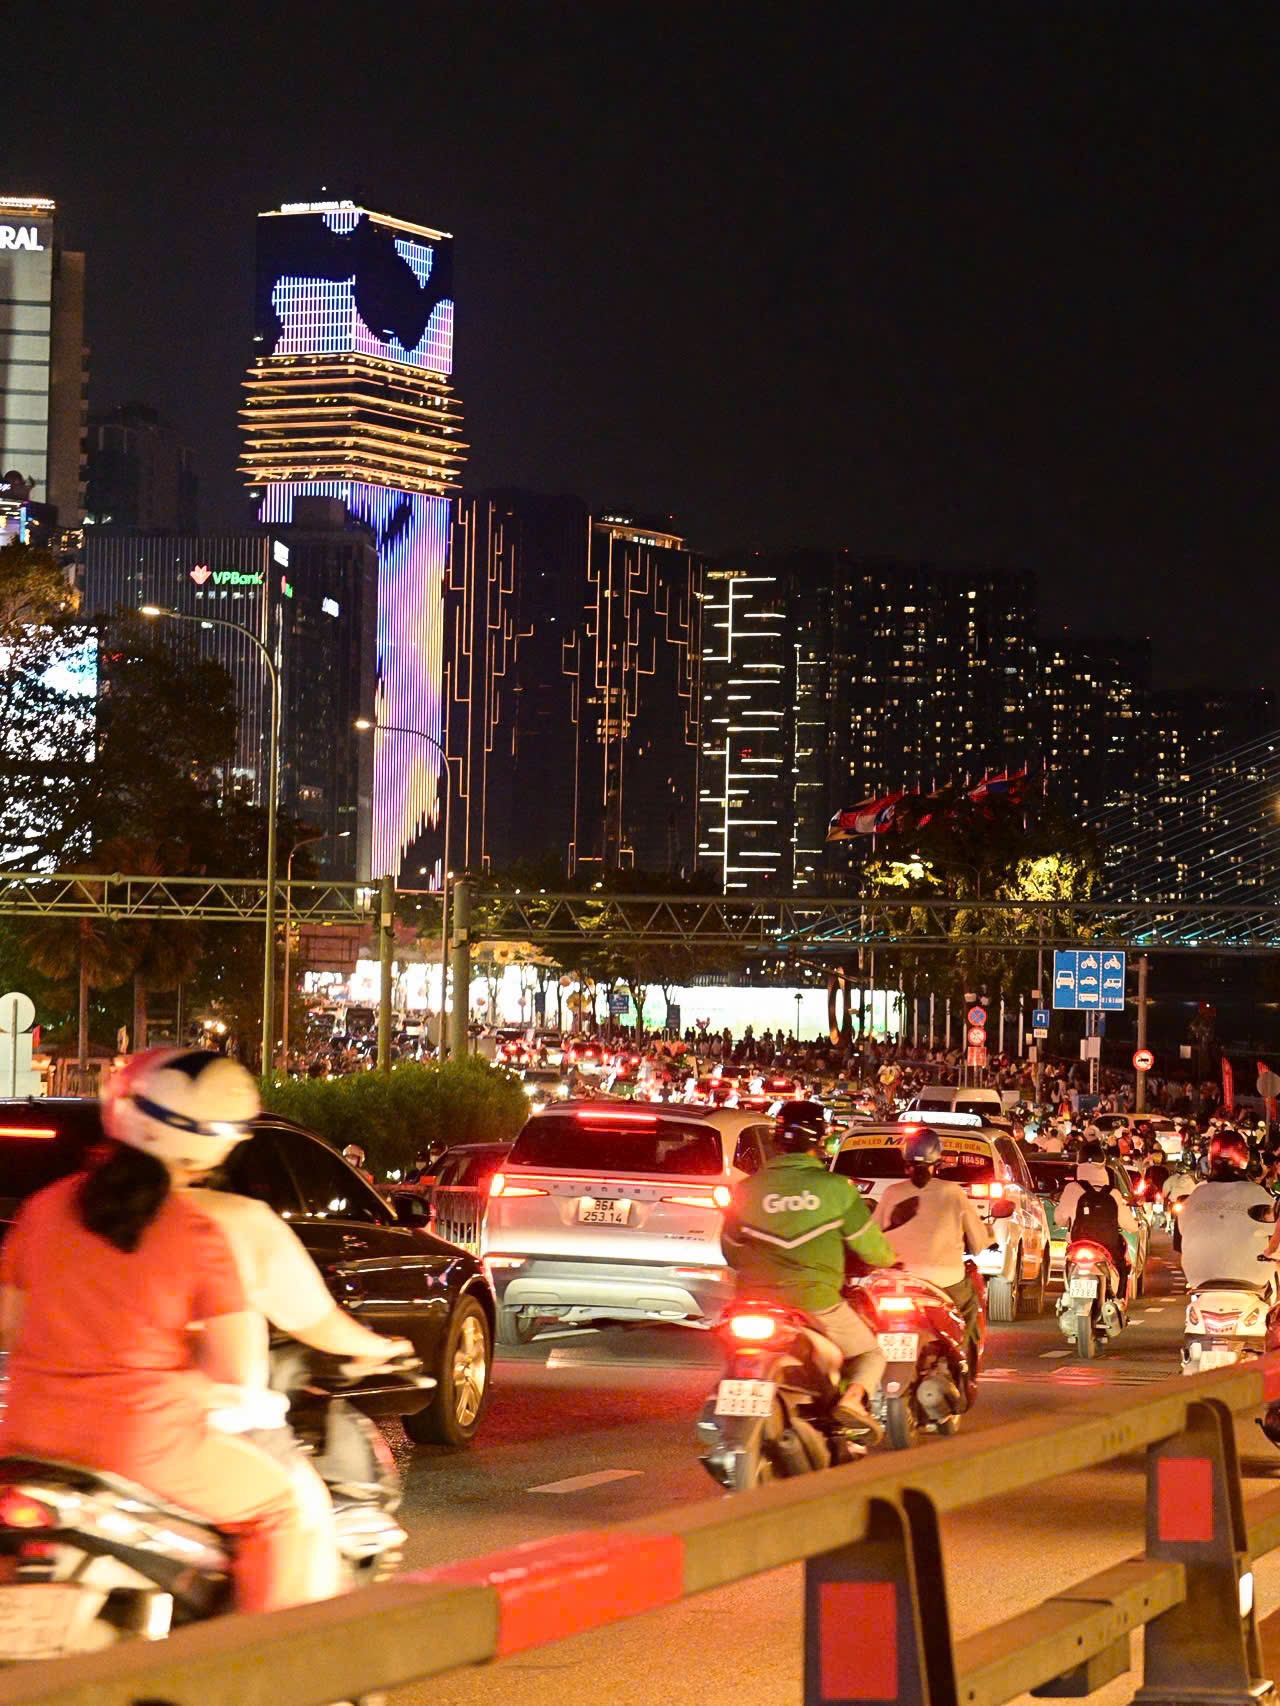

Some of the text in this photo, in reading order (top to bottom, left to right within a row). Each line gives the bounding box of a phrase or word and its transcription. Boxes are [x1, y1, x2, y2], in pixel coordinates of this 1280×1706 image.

[0, 225, 44, 251] RAL
[212, 571, 264, 585] VPBank
[762, 1189, 821, 1214] Grab
[583, 1211, 622, 1223] 253.14
